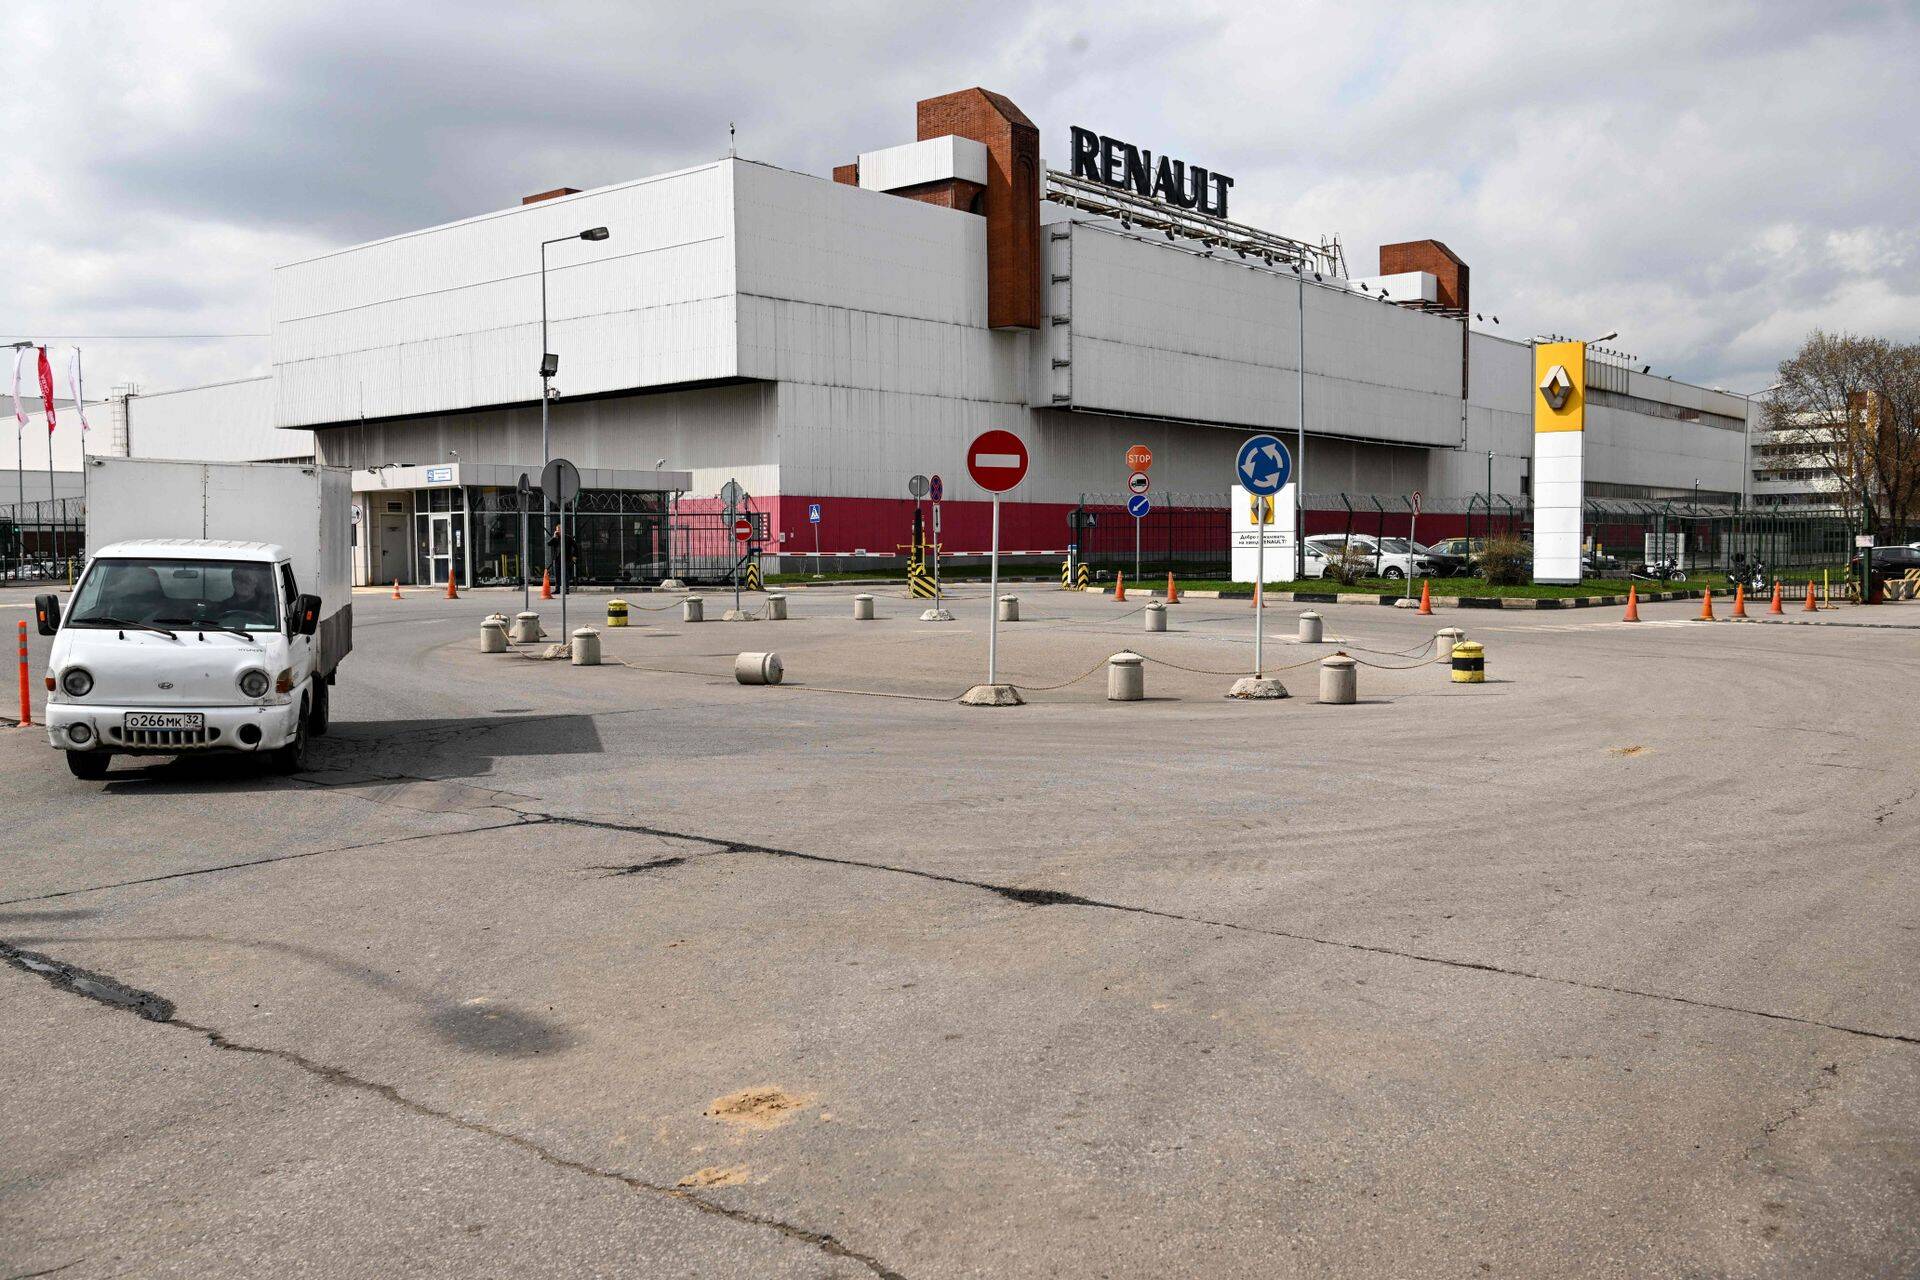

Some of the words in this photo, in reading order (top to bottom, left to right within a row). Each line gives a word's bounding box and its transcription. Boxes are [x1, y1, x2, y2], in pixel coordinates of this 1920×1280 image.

[1070, 125, 1234, 218] RENAULT
[1128, 454, 1151, 463] STOP
[186, 714, 199, 724] 32
